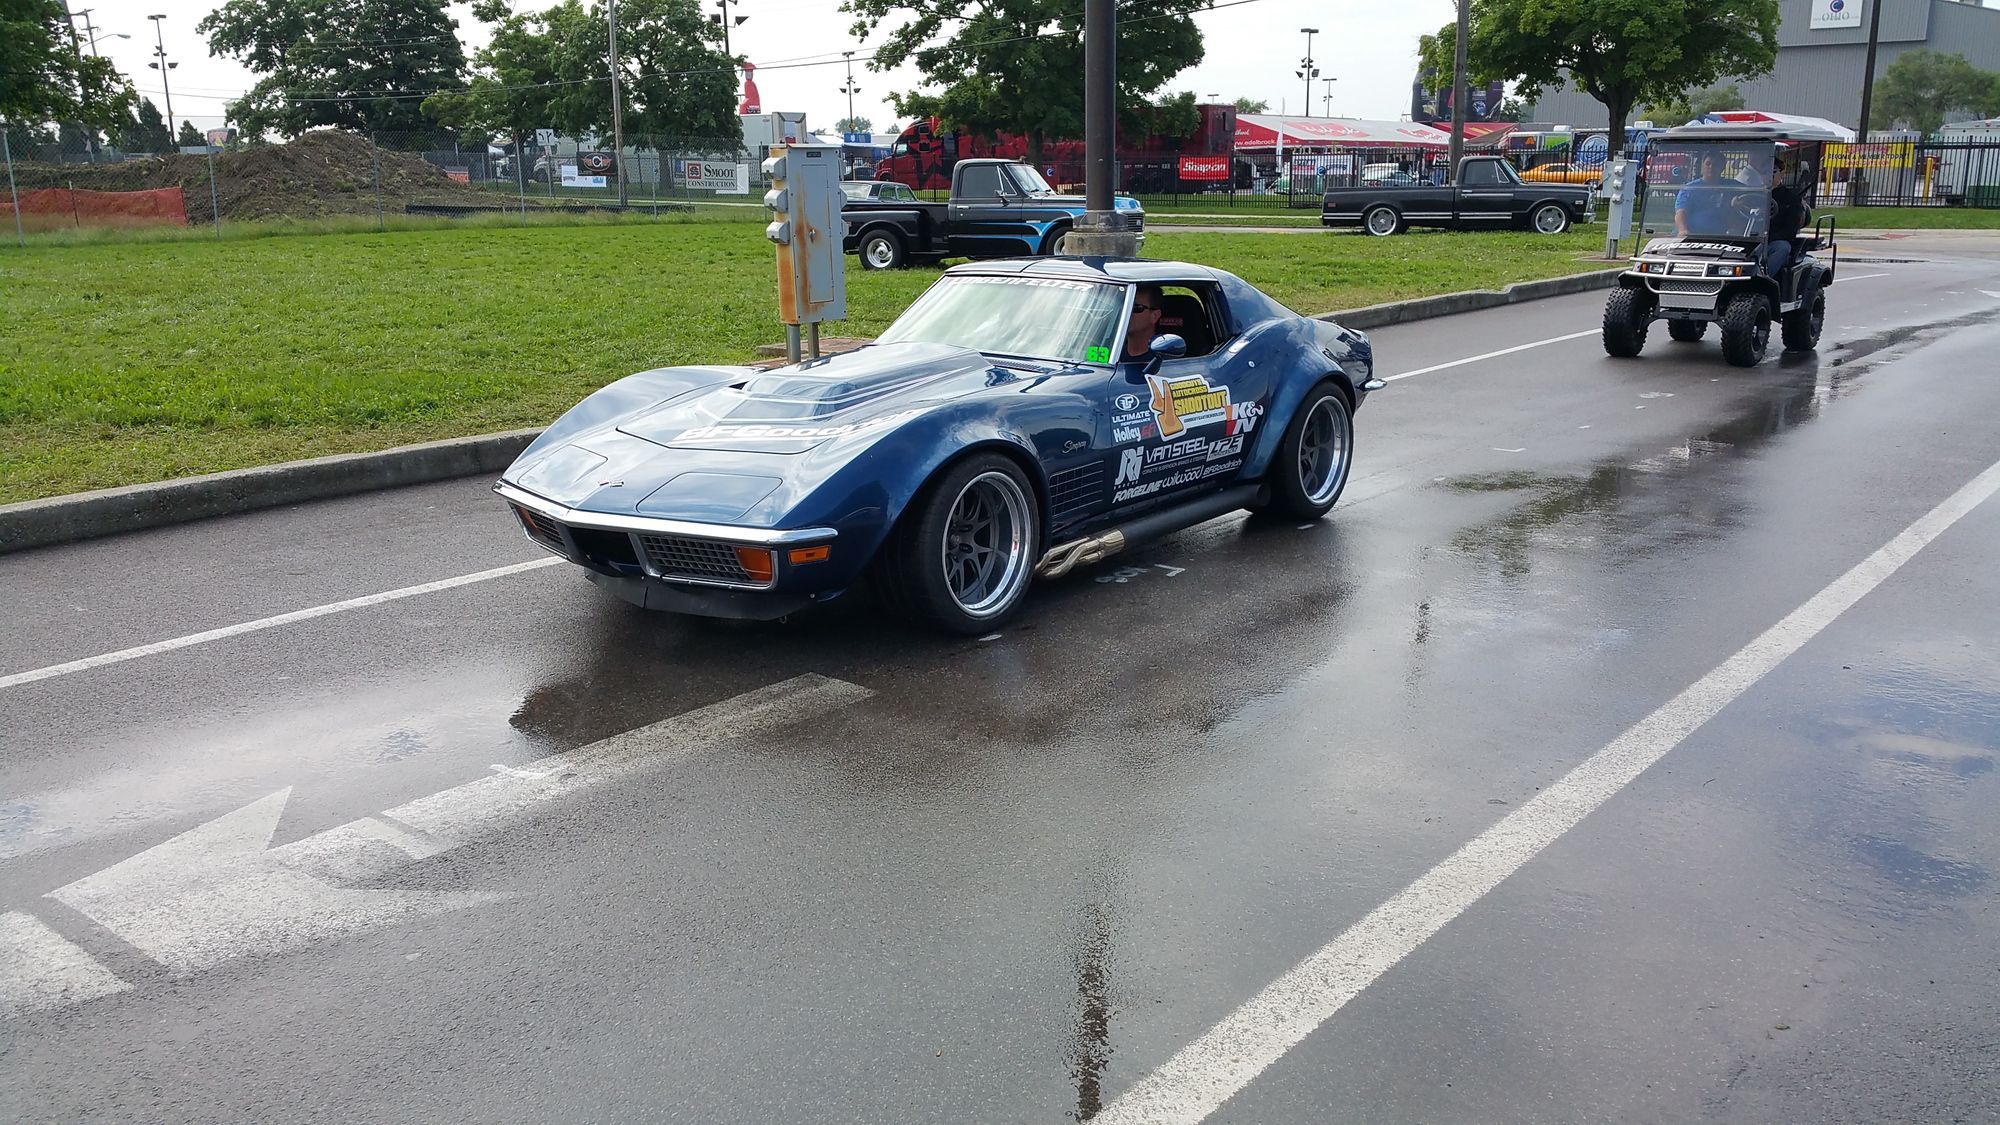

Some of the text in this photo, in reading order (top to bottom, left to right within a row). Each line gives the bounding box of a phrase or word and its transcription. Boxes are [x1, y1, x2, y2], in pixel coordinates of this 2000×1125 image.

[704, 164, 735, 179] SMOOT
[687, 179, 736, 188] CONSTRUCTION
[1651, 242, 1745, 253] LINGENFELTER
[1087, 346, 1110, 364] 63
[1172, 385, 1208, 397] AUTOCROSS
[1174, 391, 1227, 415] SHOOTOUT
[1112, 410, 1151, 423] ULTIMATE
[1113, 426, 1142, 443] Holley
[1162, 465, 1205, 488] wilwood
[1112, 479, 1164, 504] FORGELINE
